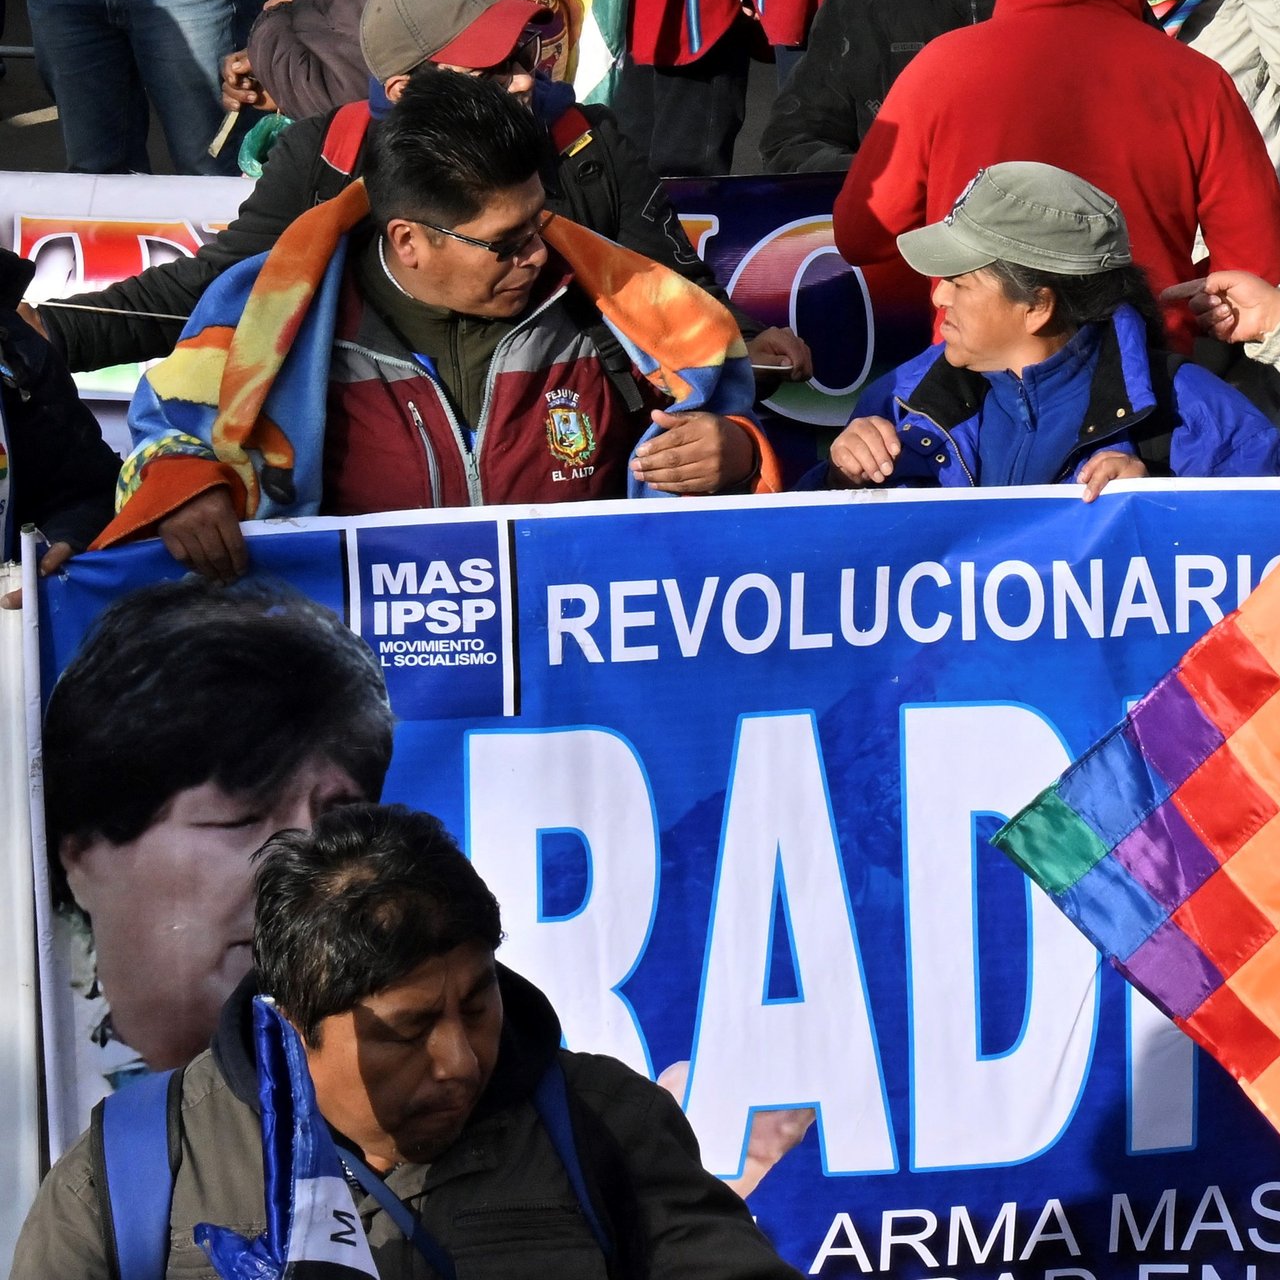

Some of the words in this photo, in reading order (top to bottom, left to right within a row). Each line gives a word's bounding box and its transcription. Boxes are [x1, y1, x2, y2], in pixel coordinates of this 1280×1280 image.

[545, 388, 580, 402] FEJUVE
[552, 470, 566, 482] EL
[571, 466, 594, 480] ALTO
[371, 558, 495, 595] MAS
[373, 598, 497, 636] IPSP
[379, 638, 485, 654] MOVIMIENTO
[394, 652, 498, 667] SOCIALISMO
[808, 1197, 1082, 1275] ARMA
